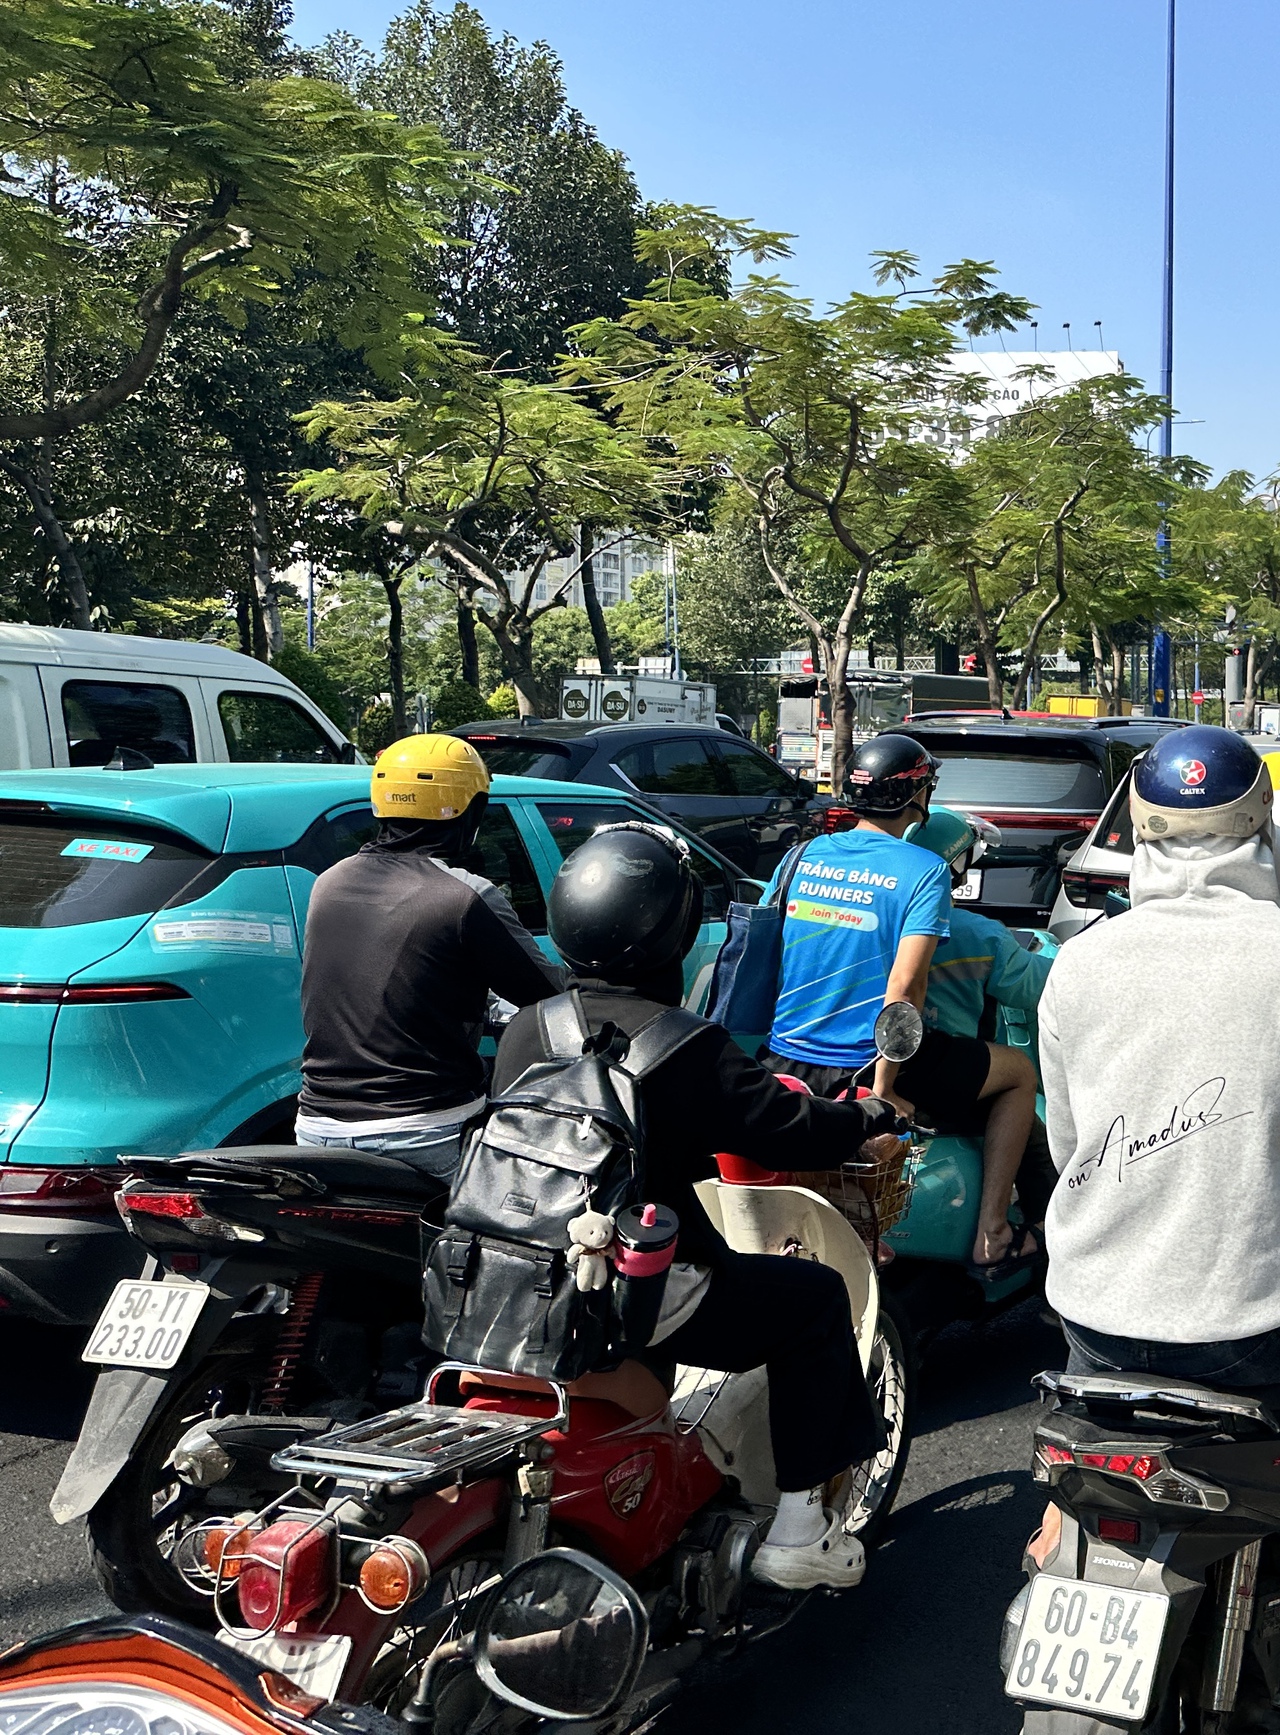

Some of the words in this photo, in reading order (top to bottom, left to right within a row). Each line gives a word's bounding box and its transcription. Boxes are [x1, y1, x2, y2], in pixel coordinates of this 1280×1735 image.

[76, 844, 99, 852] XE
[103, 845, 140, 857] TAXI
[798, 880, 874, 905] RUNNERS
[810, 908, 831, 919] Join
[834, 911, 863, 925] Today
[118, 1288, 190, 1323] 50-Y1
[91, 1323, 182, 1361] 233.00
[622, 1493, 641, 1513] 50
[1092, 1556, 1136, 1571] HONDA
[1044, 1586, 1142, 1650] 60-B4
[1017, 1639, 1143, 1710] 849.74
